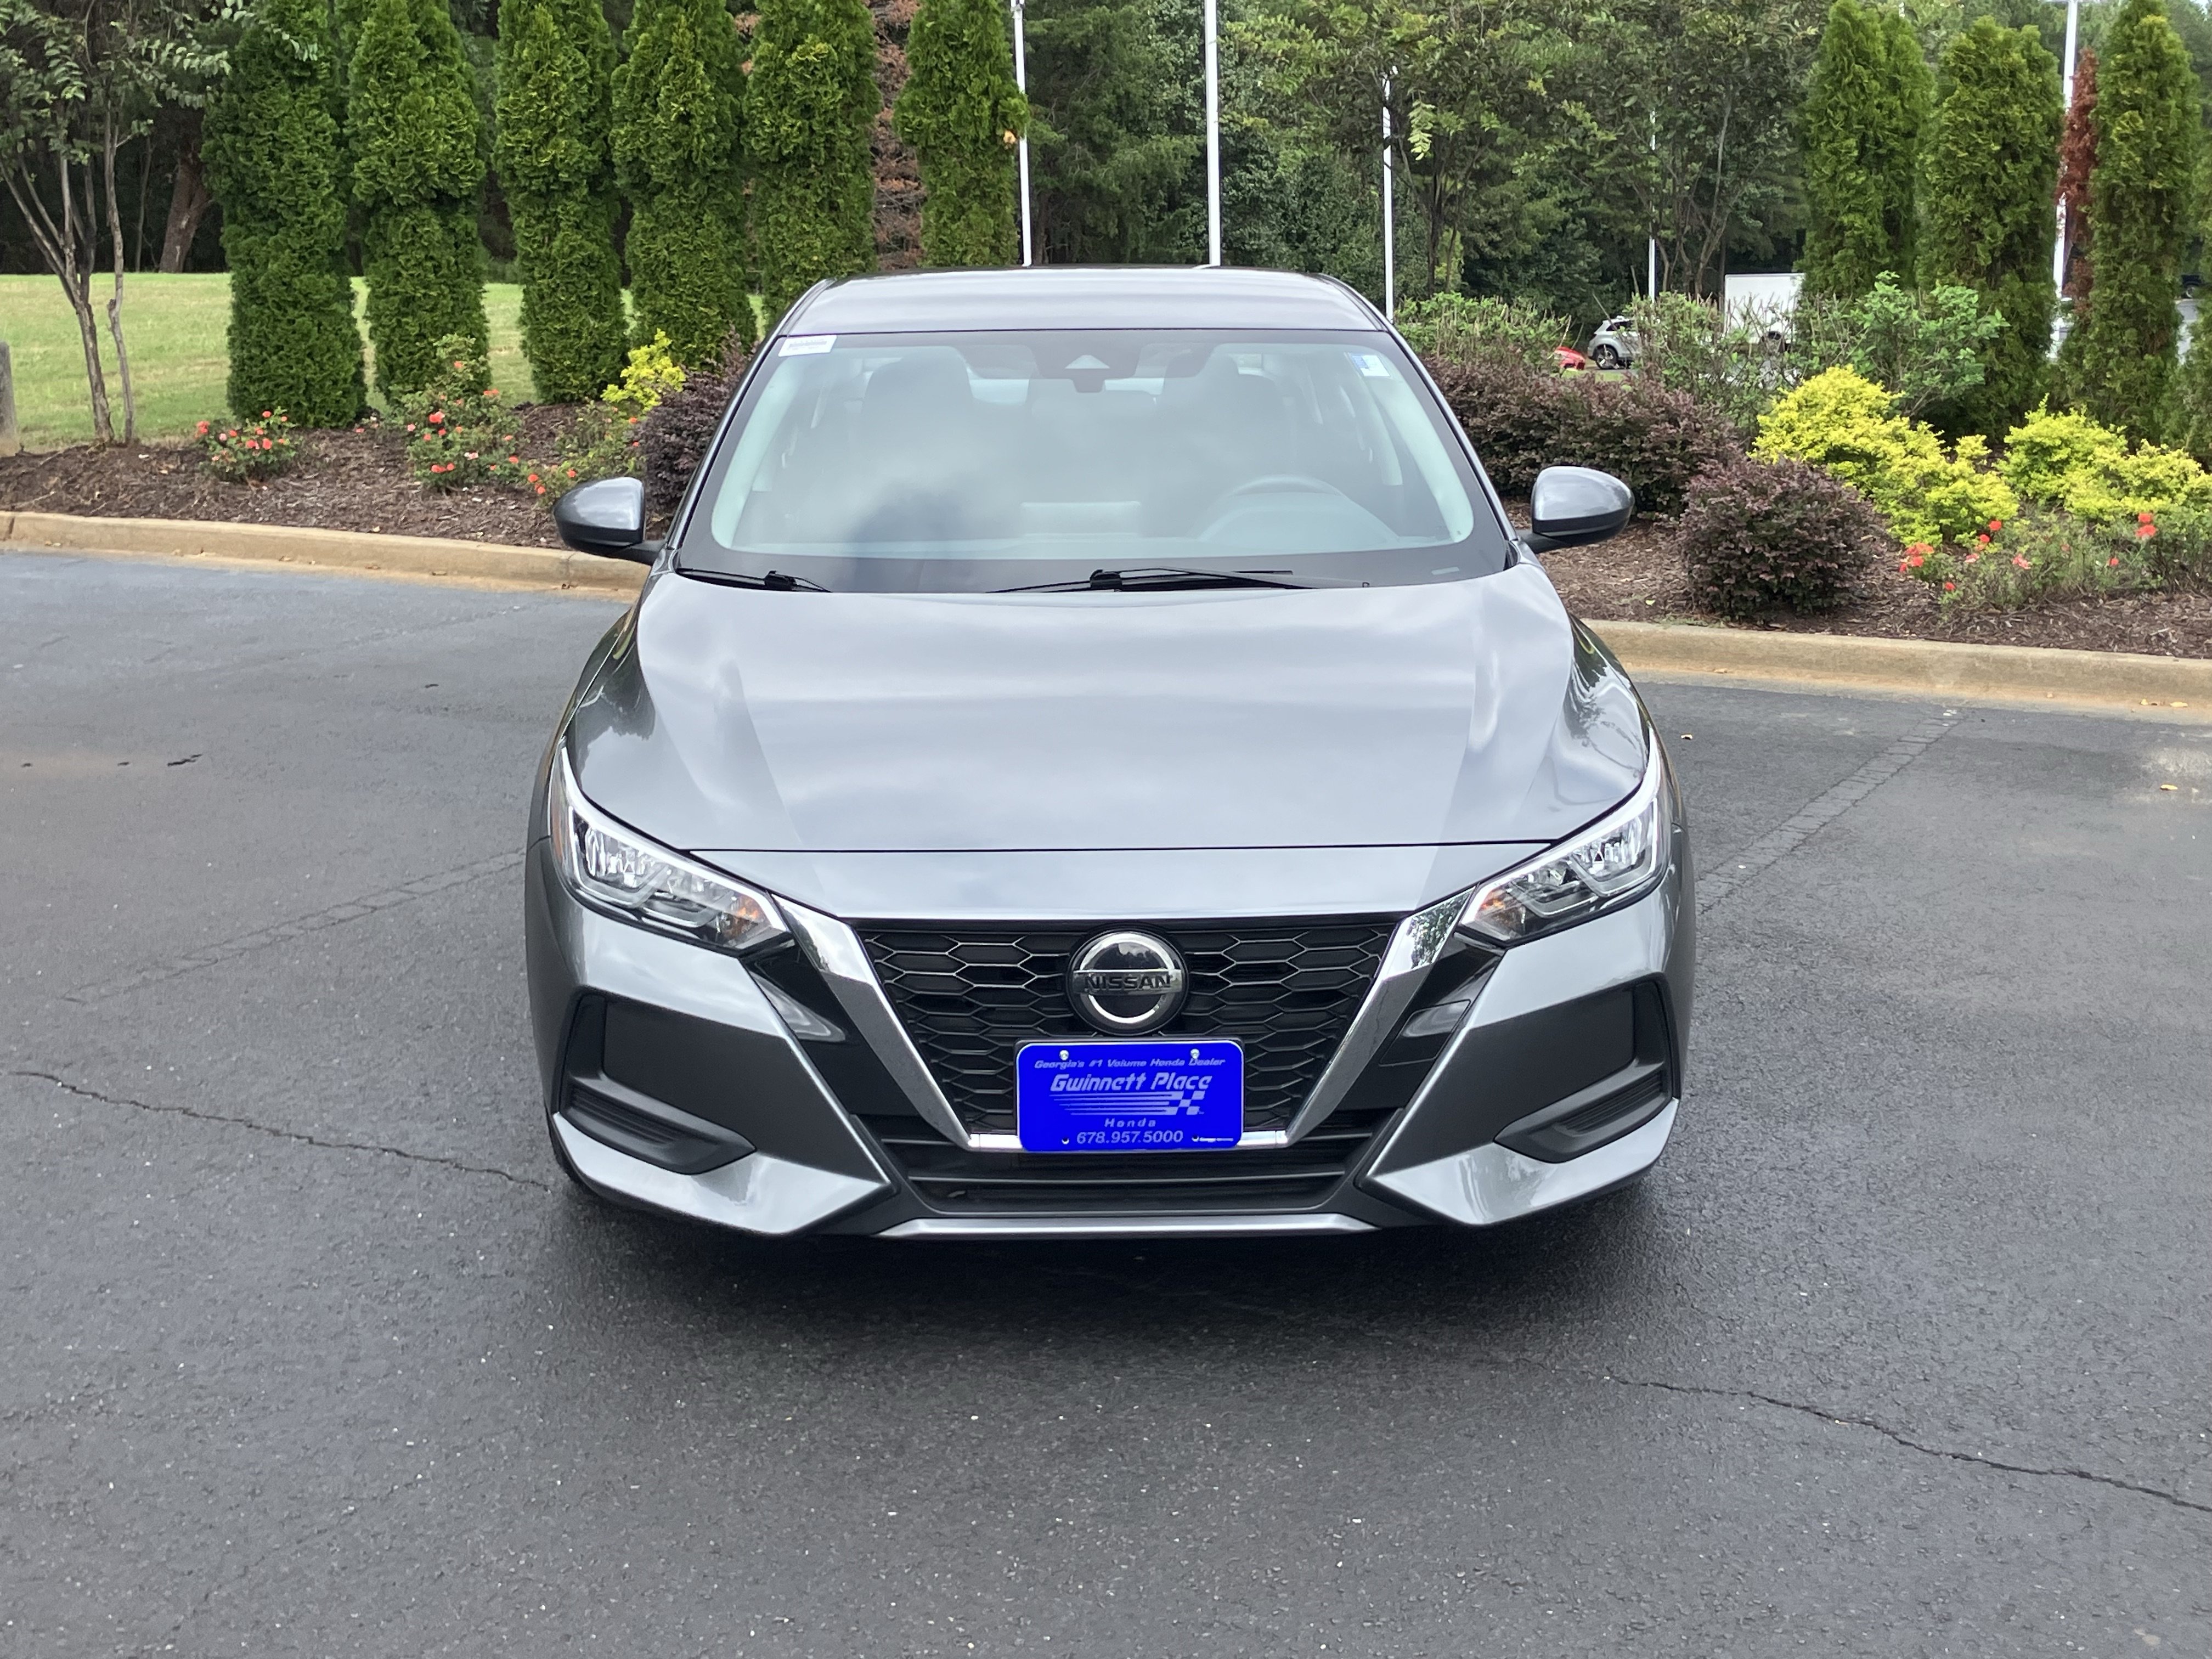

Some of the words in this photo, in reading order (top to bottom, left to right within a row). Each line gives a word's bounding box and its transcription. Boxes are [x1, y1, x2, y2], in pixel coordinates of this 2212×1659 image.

[1085, 974, 1171, 990] NISSAN
[1034, 1059, 1084, 1069] Georgia's
[1088, 1059, 1102, 1068] #1
[1107, 1059, 1147, 1068] Volume
[1150, 1058, 1185, 1066] Honda
[1188, 1058, 1226, 1066] Dealer
[1050, 1072, 1147, 1092] Gwinnett
[1150, 1072, 1212, 1091] Place
[1104, 1118, 1156, 1128] Honda
[1076, 1130, 1183, 1144] 678.957.5000
